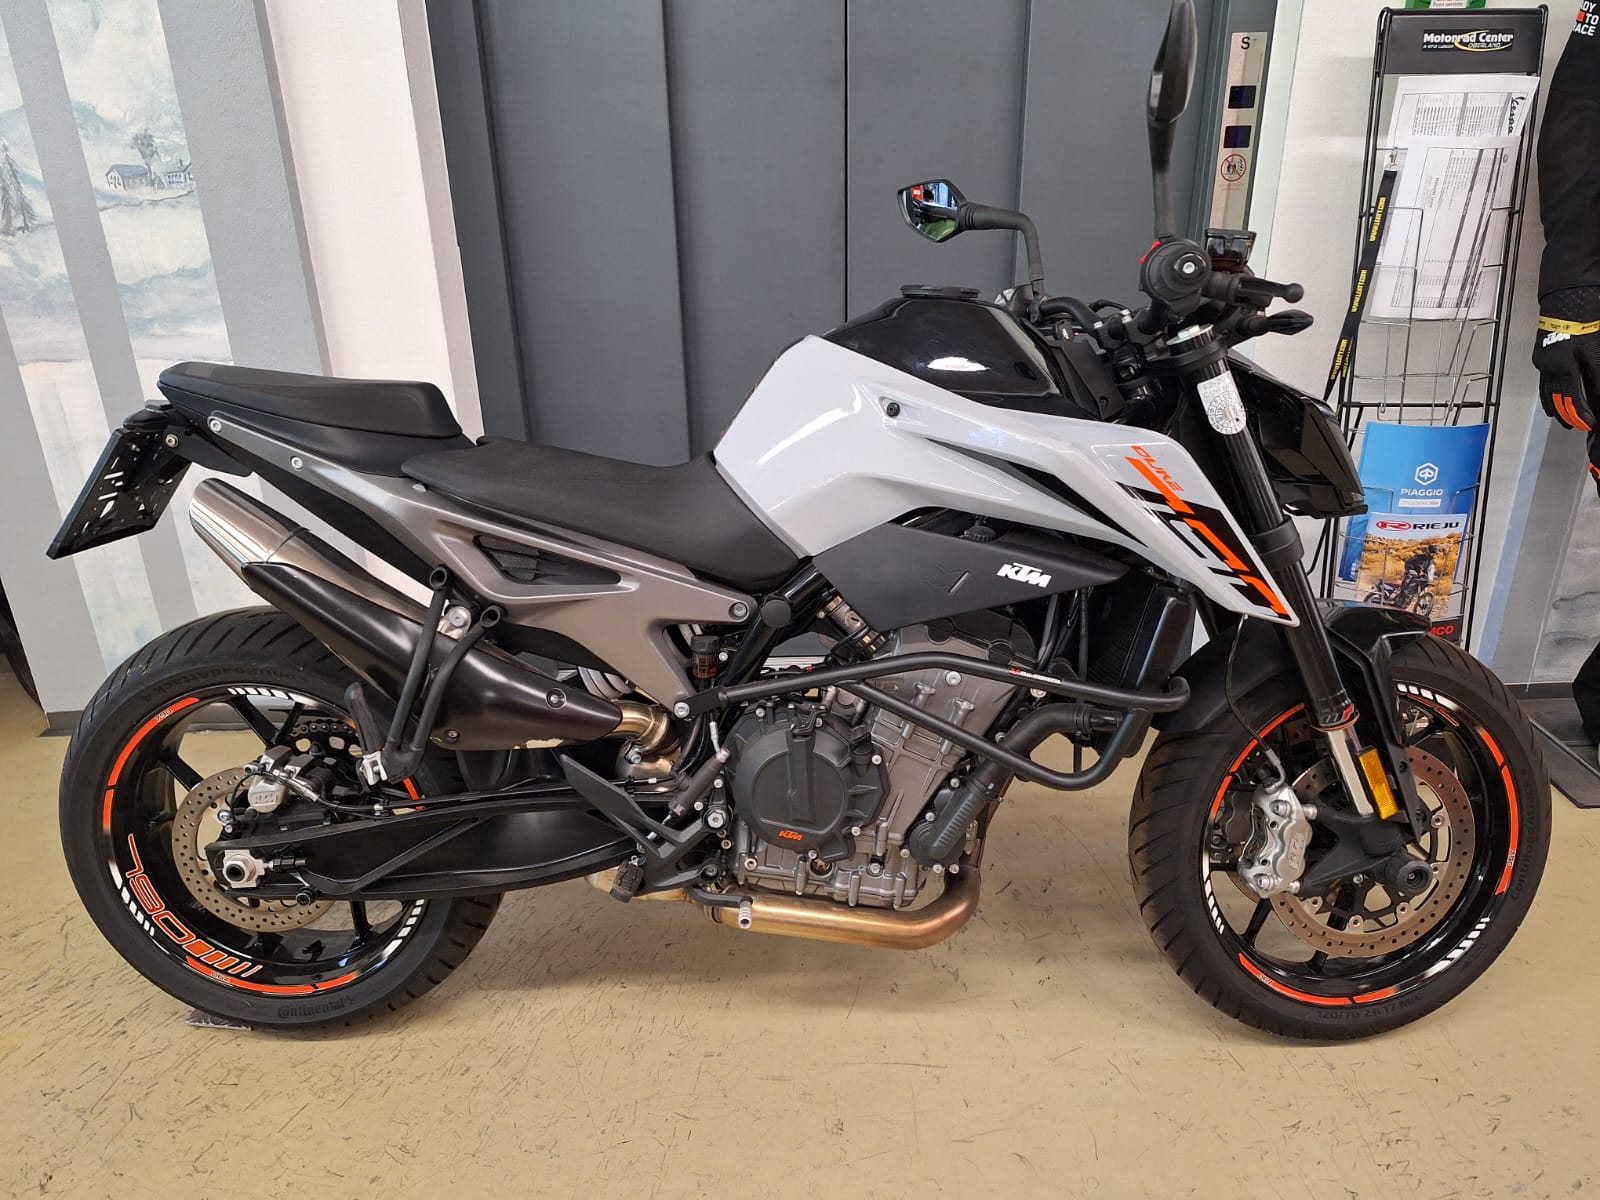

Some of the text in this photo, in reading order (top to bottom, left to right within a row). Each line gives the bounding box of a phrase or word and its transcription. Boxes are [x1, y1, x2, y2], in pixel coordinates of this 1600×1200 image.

[1585, 13, 1599, 25] TO
[1574, 22, 1596, 36] ACE
[1423, 32, 1513, 43] Motorrad Center
[1130, 445, 1185, 492] DUKE
[1400, 488, 1444, 497] PIAGGIO
[1412, 522, 1460, 530] RIEJU
[996, 562, 1052, 588] KTM
[779, 830, 803, 841] KTM
